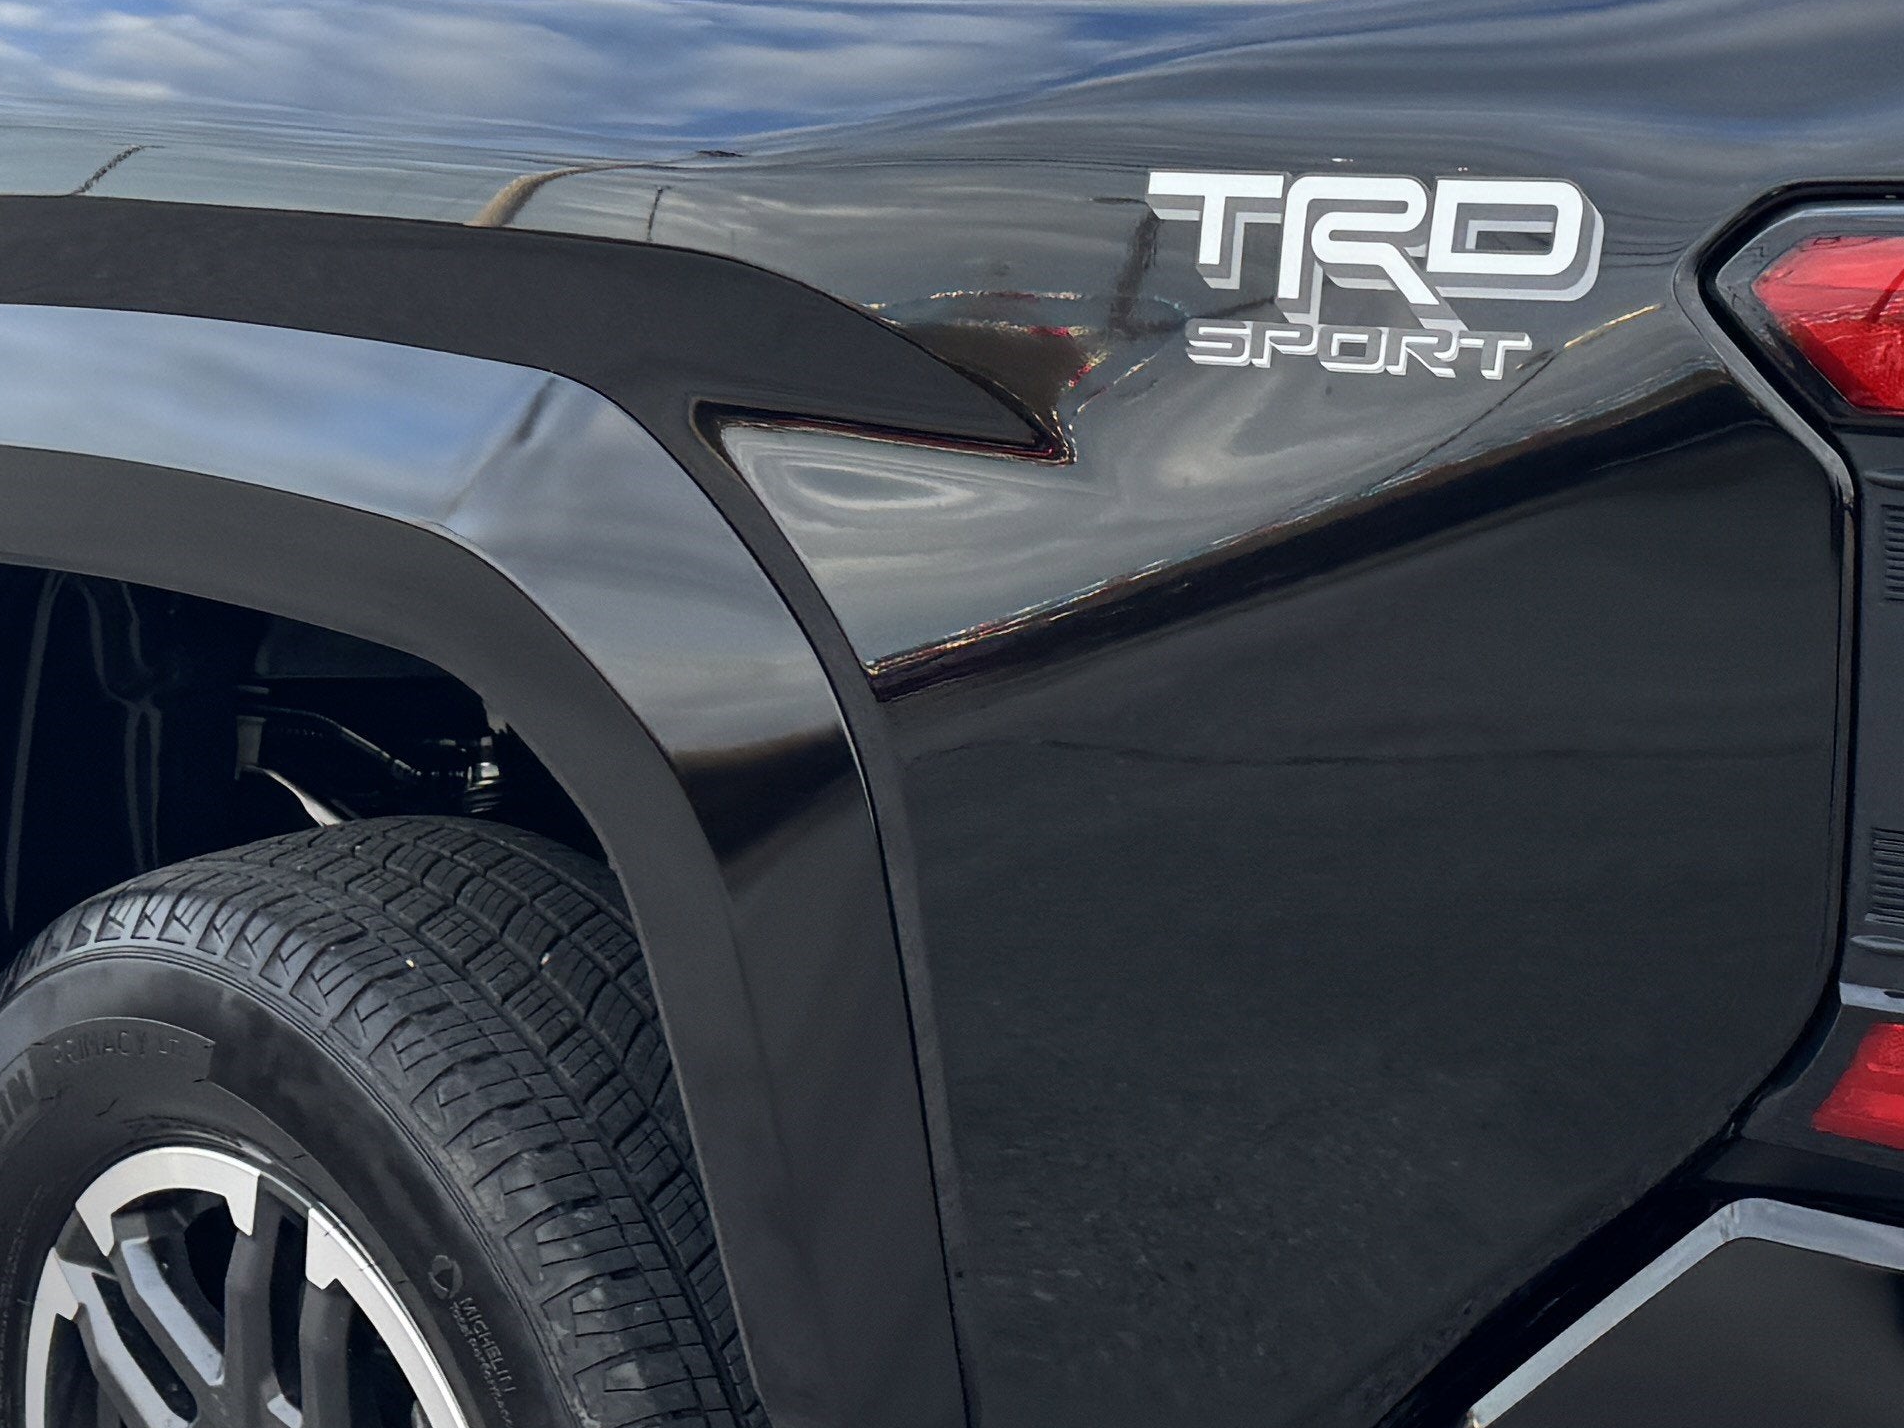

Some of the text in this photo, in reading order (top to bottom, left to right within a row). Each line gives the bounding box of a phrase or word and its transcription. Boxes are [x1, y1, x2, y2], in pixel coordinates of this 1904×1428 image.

[1146, 170, 1604, 330] TRD
[1186, 318, 1533, 380] SPORT
[458, 1296, 517, 1393] MICHELIN
